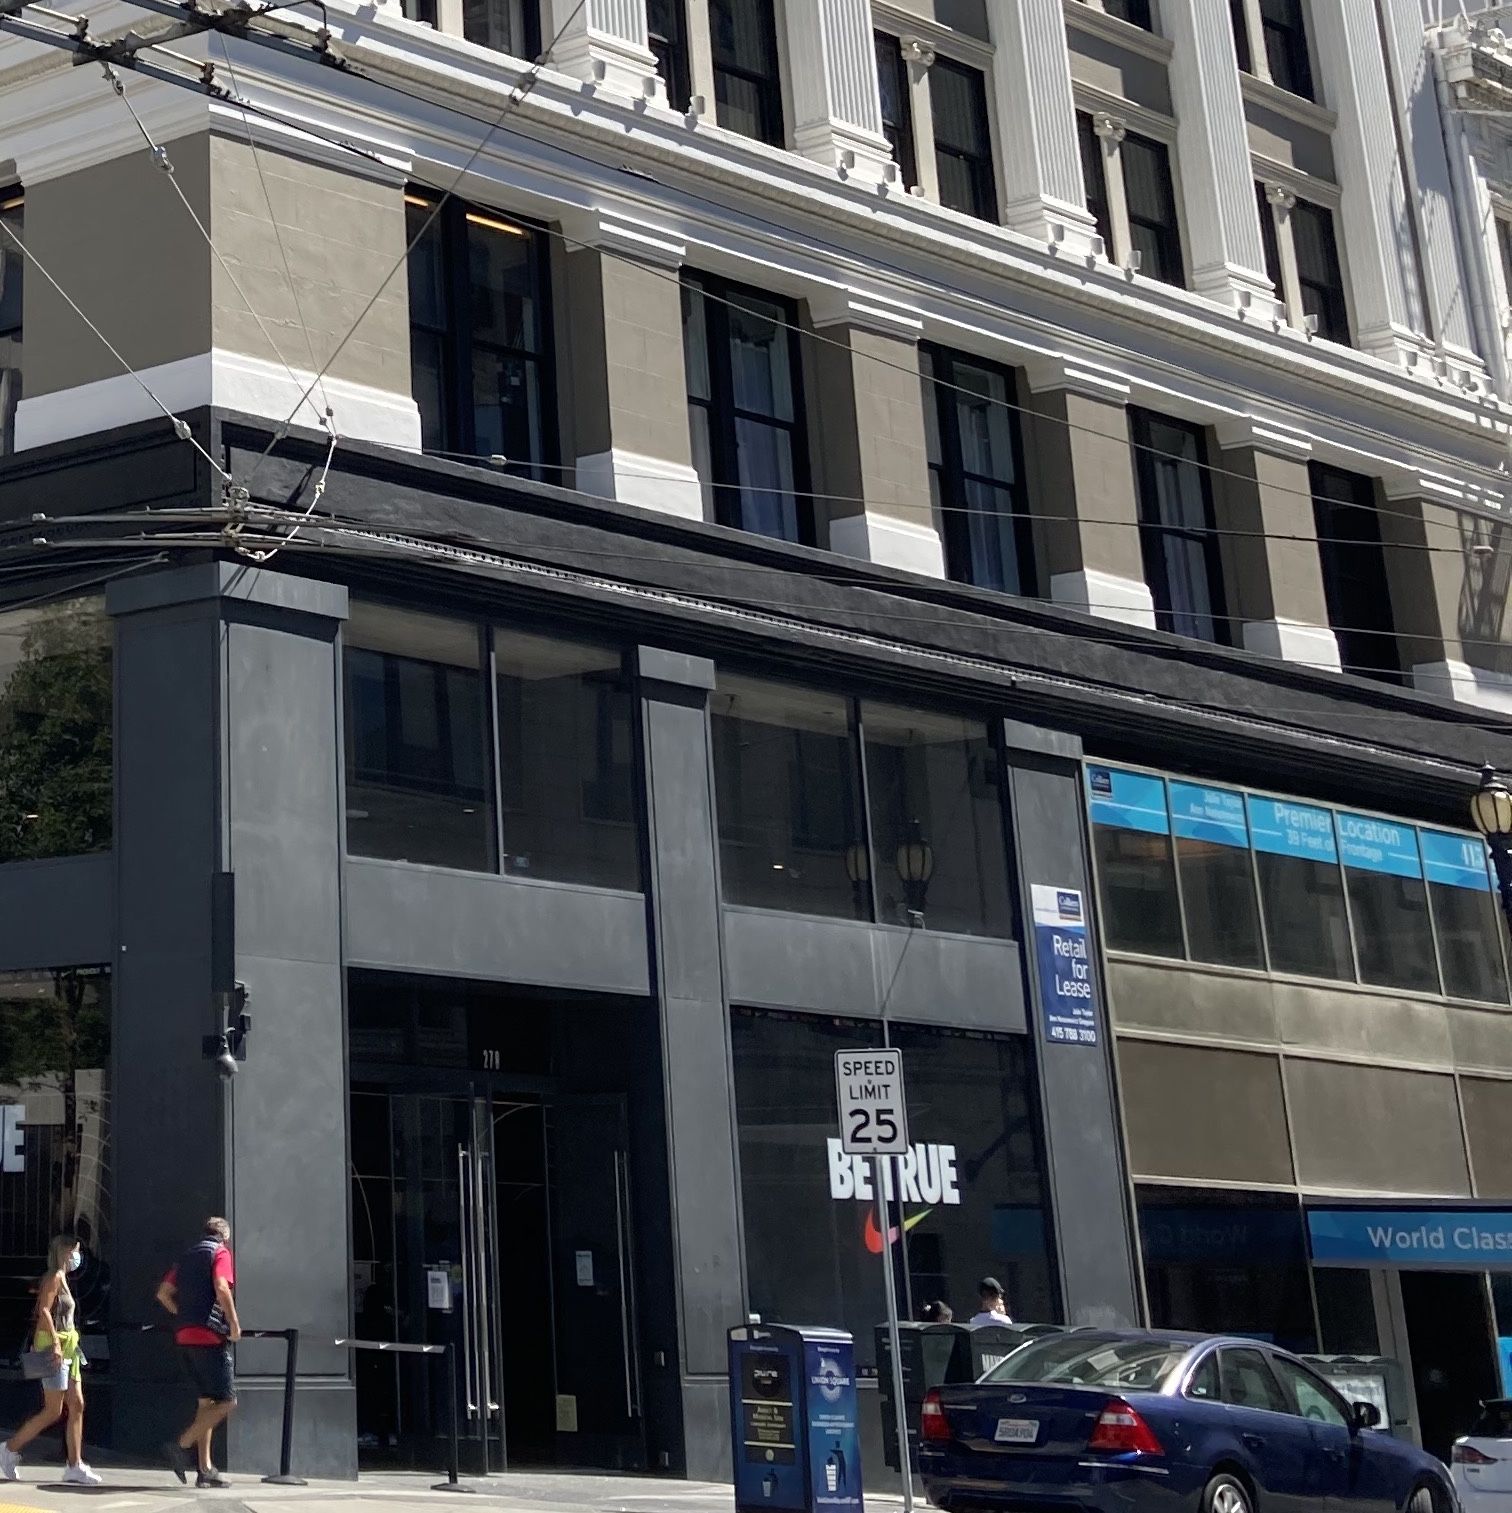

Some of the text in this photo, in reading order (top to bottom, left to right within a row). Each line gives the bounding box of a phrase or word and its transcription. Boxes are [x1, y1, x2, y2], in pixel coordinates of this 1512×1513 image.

[1274, 802, 1331, 832] Premier
[1337, 814, 1401, 846] Location
[1301, 832, 1322, 849] Feet
[1341, 840, 1383, 862] Frontage
[1052, 934, 1088, 959] Retail
[1071, 958, 1089, 980] for
[1055, 973, 1091, 999] Lease
[1051, 1026, 1065, 1040] 415
[1079, 1029, 1096, 1043] 3100
[842, 1060, 895, 1076] SPEED
[849, 1084, 891, 1100] LIMIT
[848, 1108, 898, 1144] 25
[827, 1138, 874, 1201] BE
[1366, 1225, 1445, 1250] World
[829, 1376, 850, 1386] SQUARE
